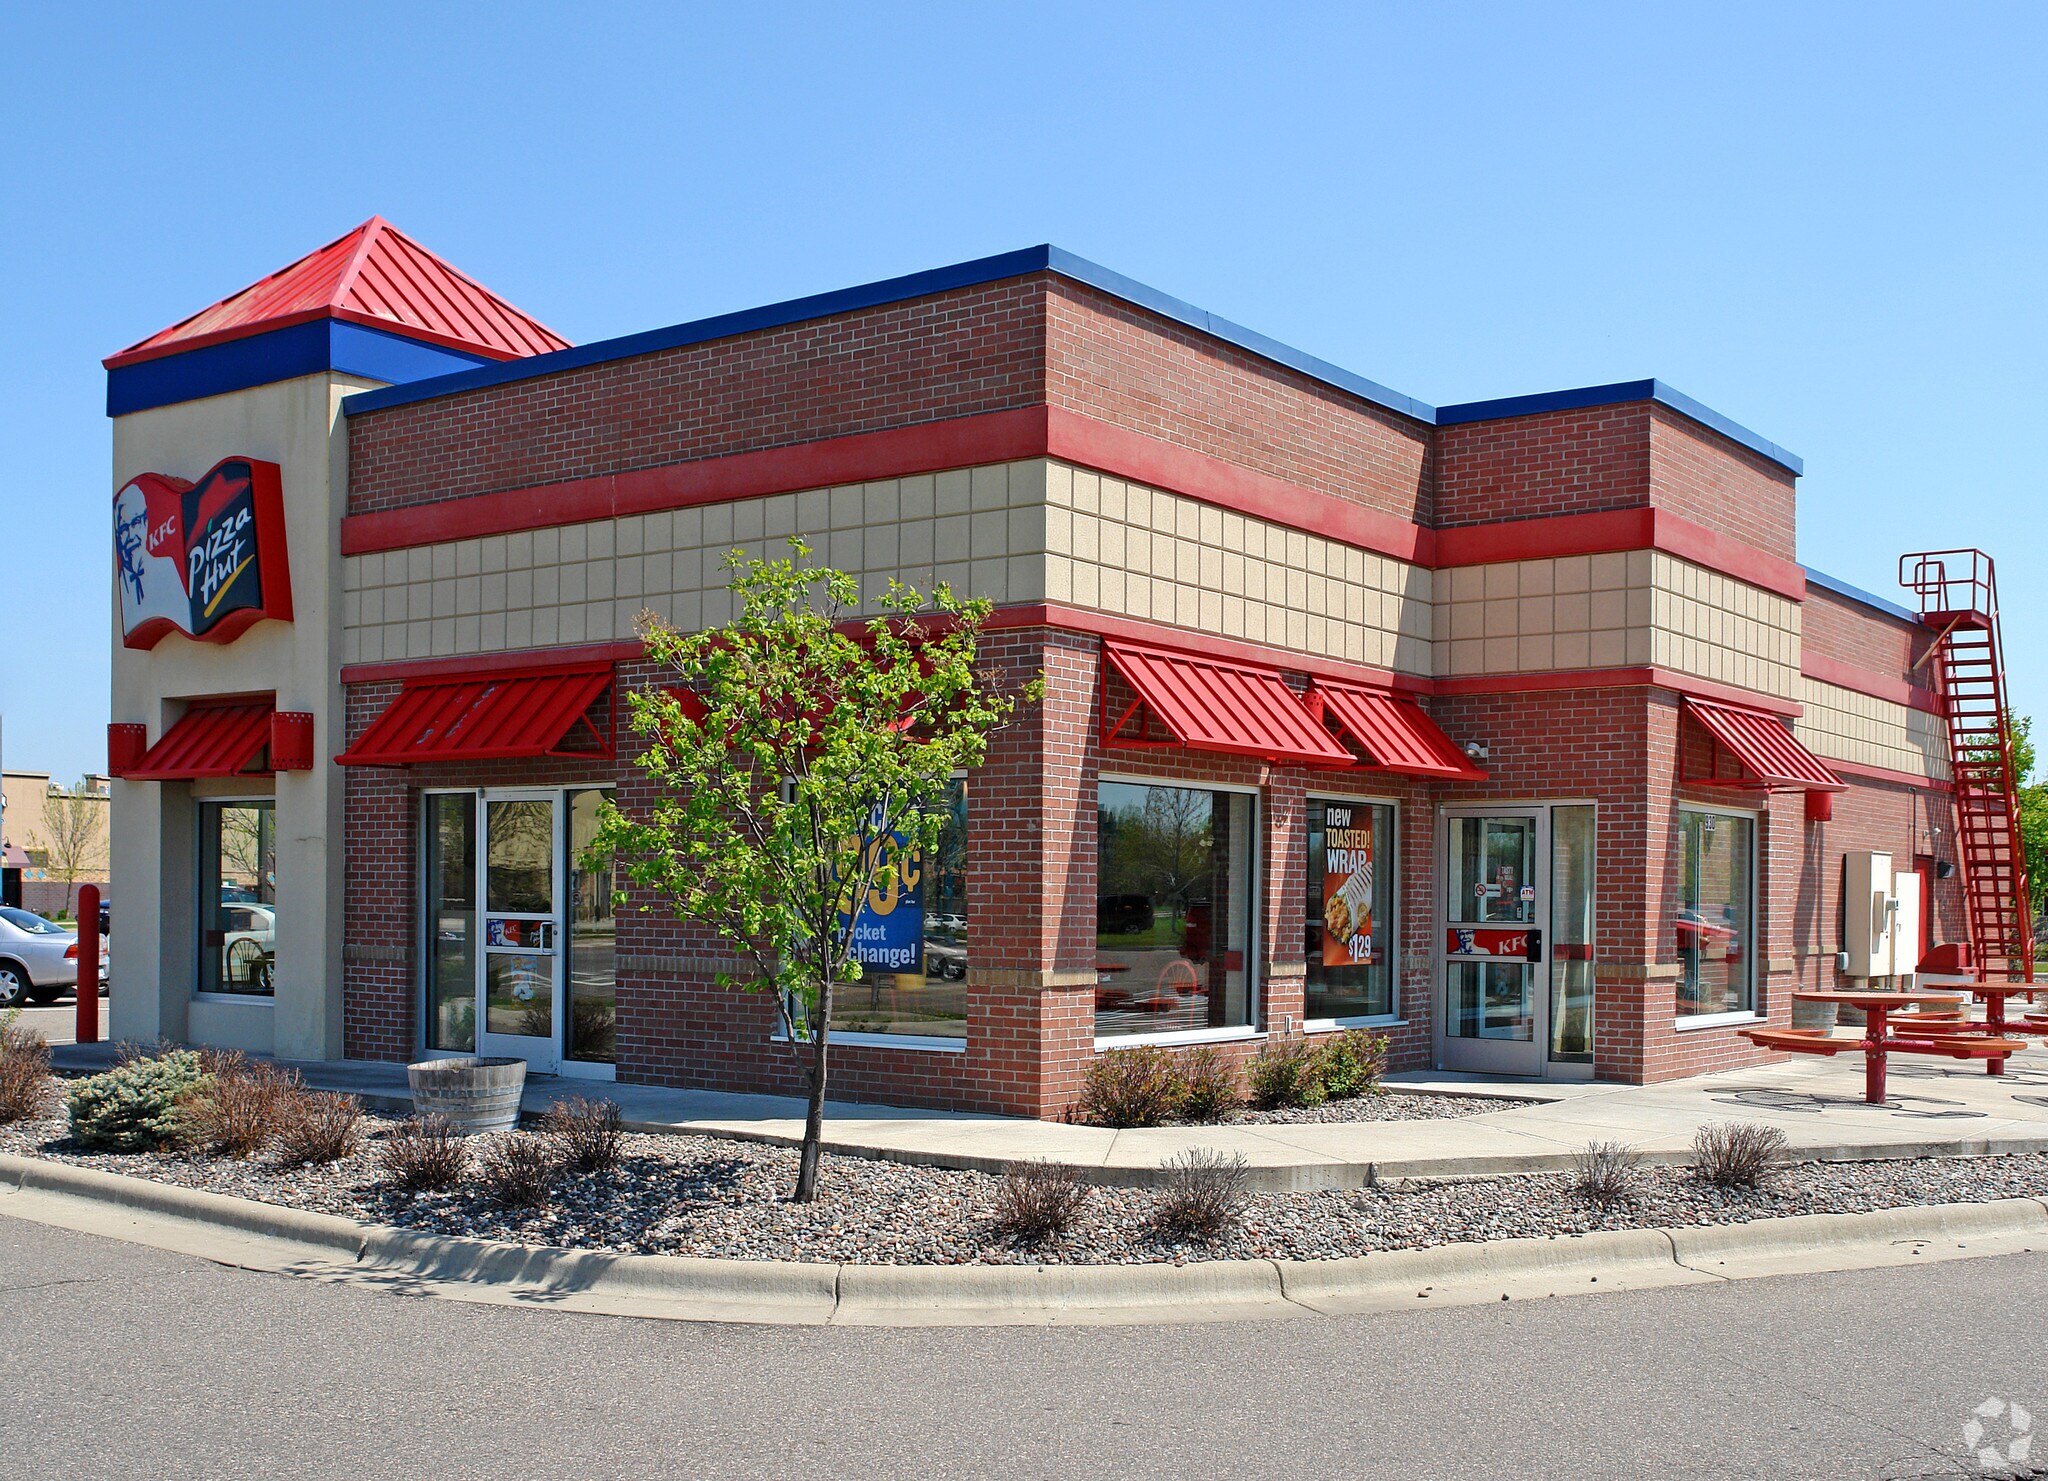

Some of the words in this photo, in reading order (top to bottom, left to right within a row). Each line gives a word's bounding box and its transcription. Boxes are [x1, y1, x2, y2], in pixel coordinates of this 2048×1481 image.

[149, 515, 176, 550] KFC
[189, 507, 252, 599] Pizza
[200, 538, 247, 605] Hut
[1326, 807, 1351, 827] new
[1326, 828, 1370, 849] TOASTED!
[1326, 848, 1367, 874] WRAP
[837, 923, 887, 943] pcket
[847, 941, 916, 969] change!
[1348, 933, 1371, 963] $129
